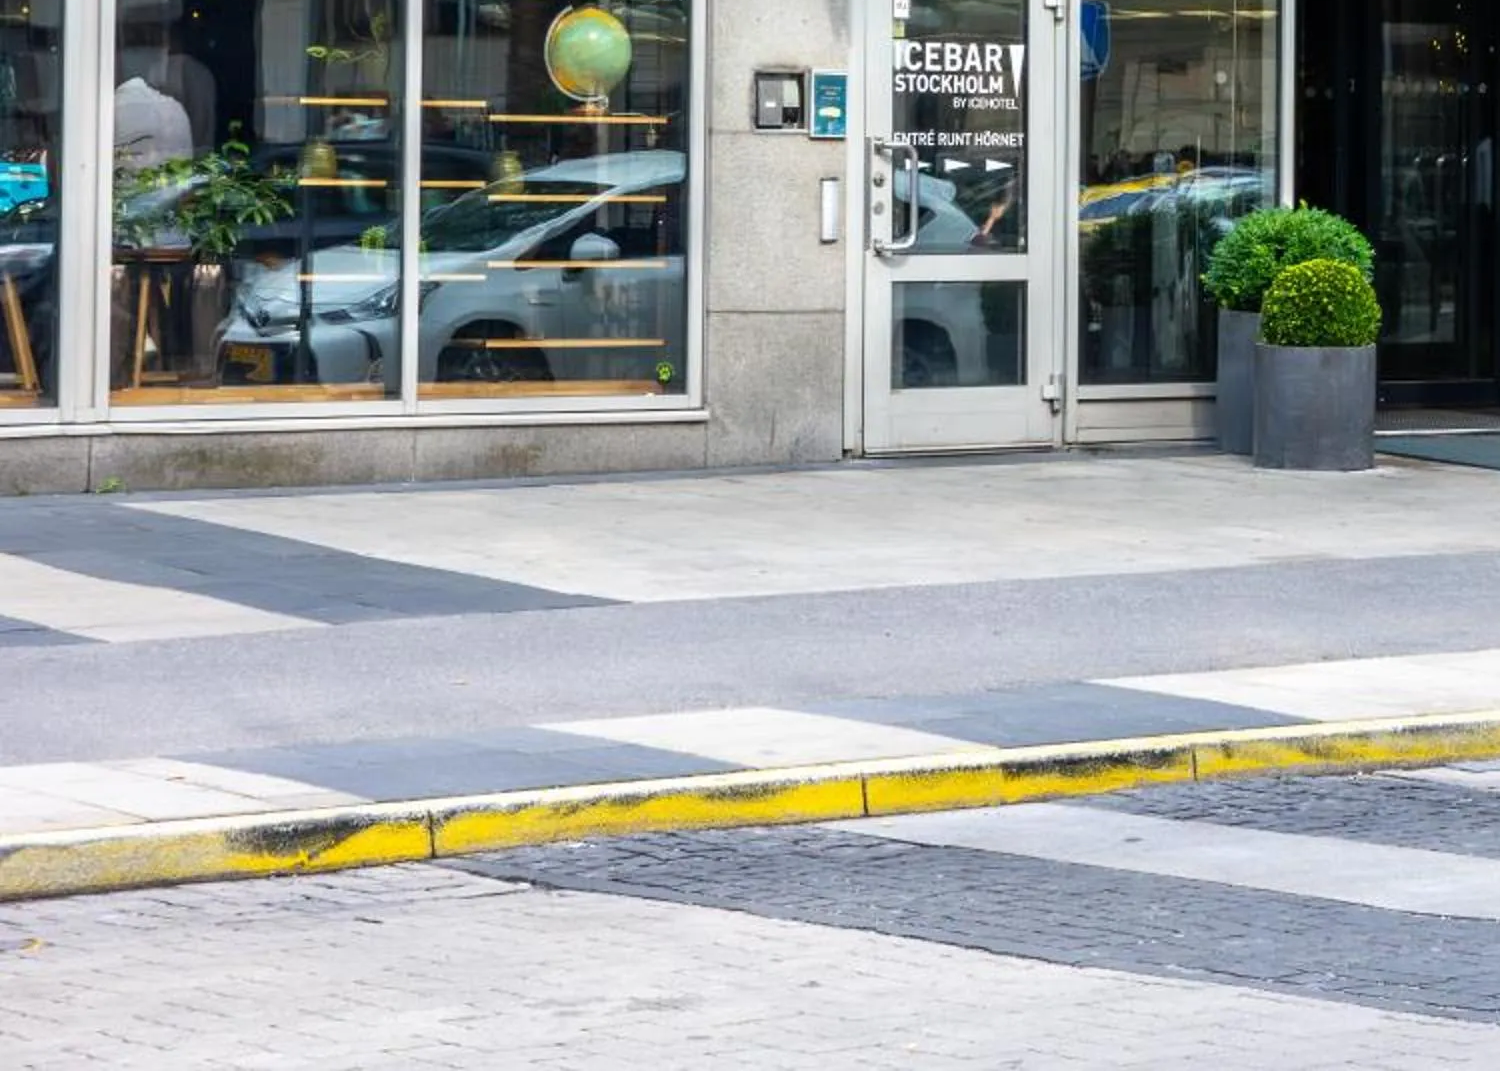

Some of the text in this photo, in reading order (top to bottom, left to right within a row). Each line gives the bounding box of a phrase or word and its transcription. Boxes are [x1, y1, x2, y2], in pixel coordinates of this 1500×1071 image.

[895, 40, 1003, 72] ICEBAR
[895, 73, 1003, 94] STOCKHOLM
[953, 97, 1018, 110] BY ICEHOTEL
[893, 129, 1025, 147] ENTRÉ RUNT HÖRNET
